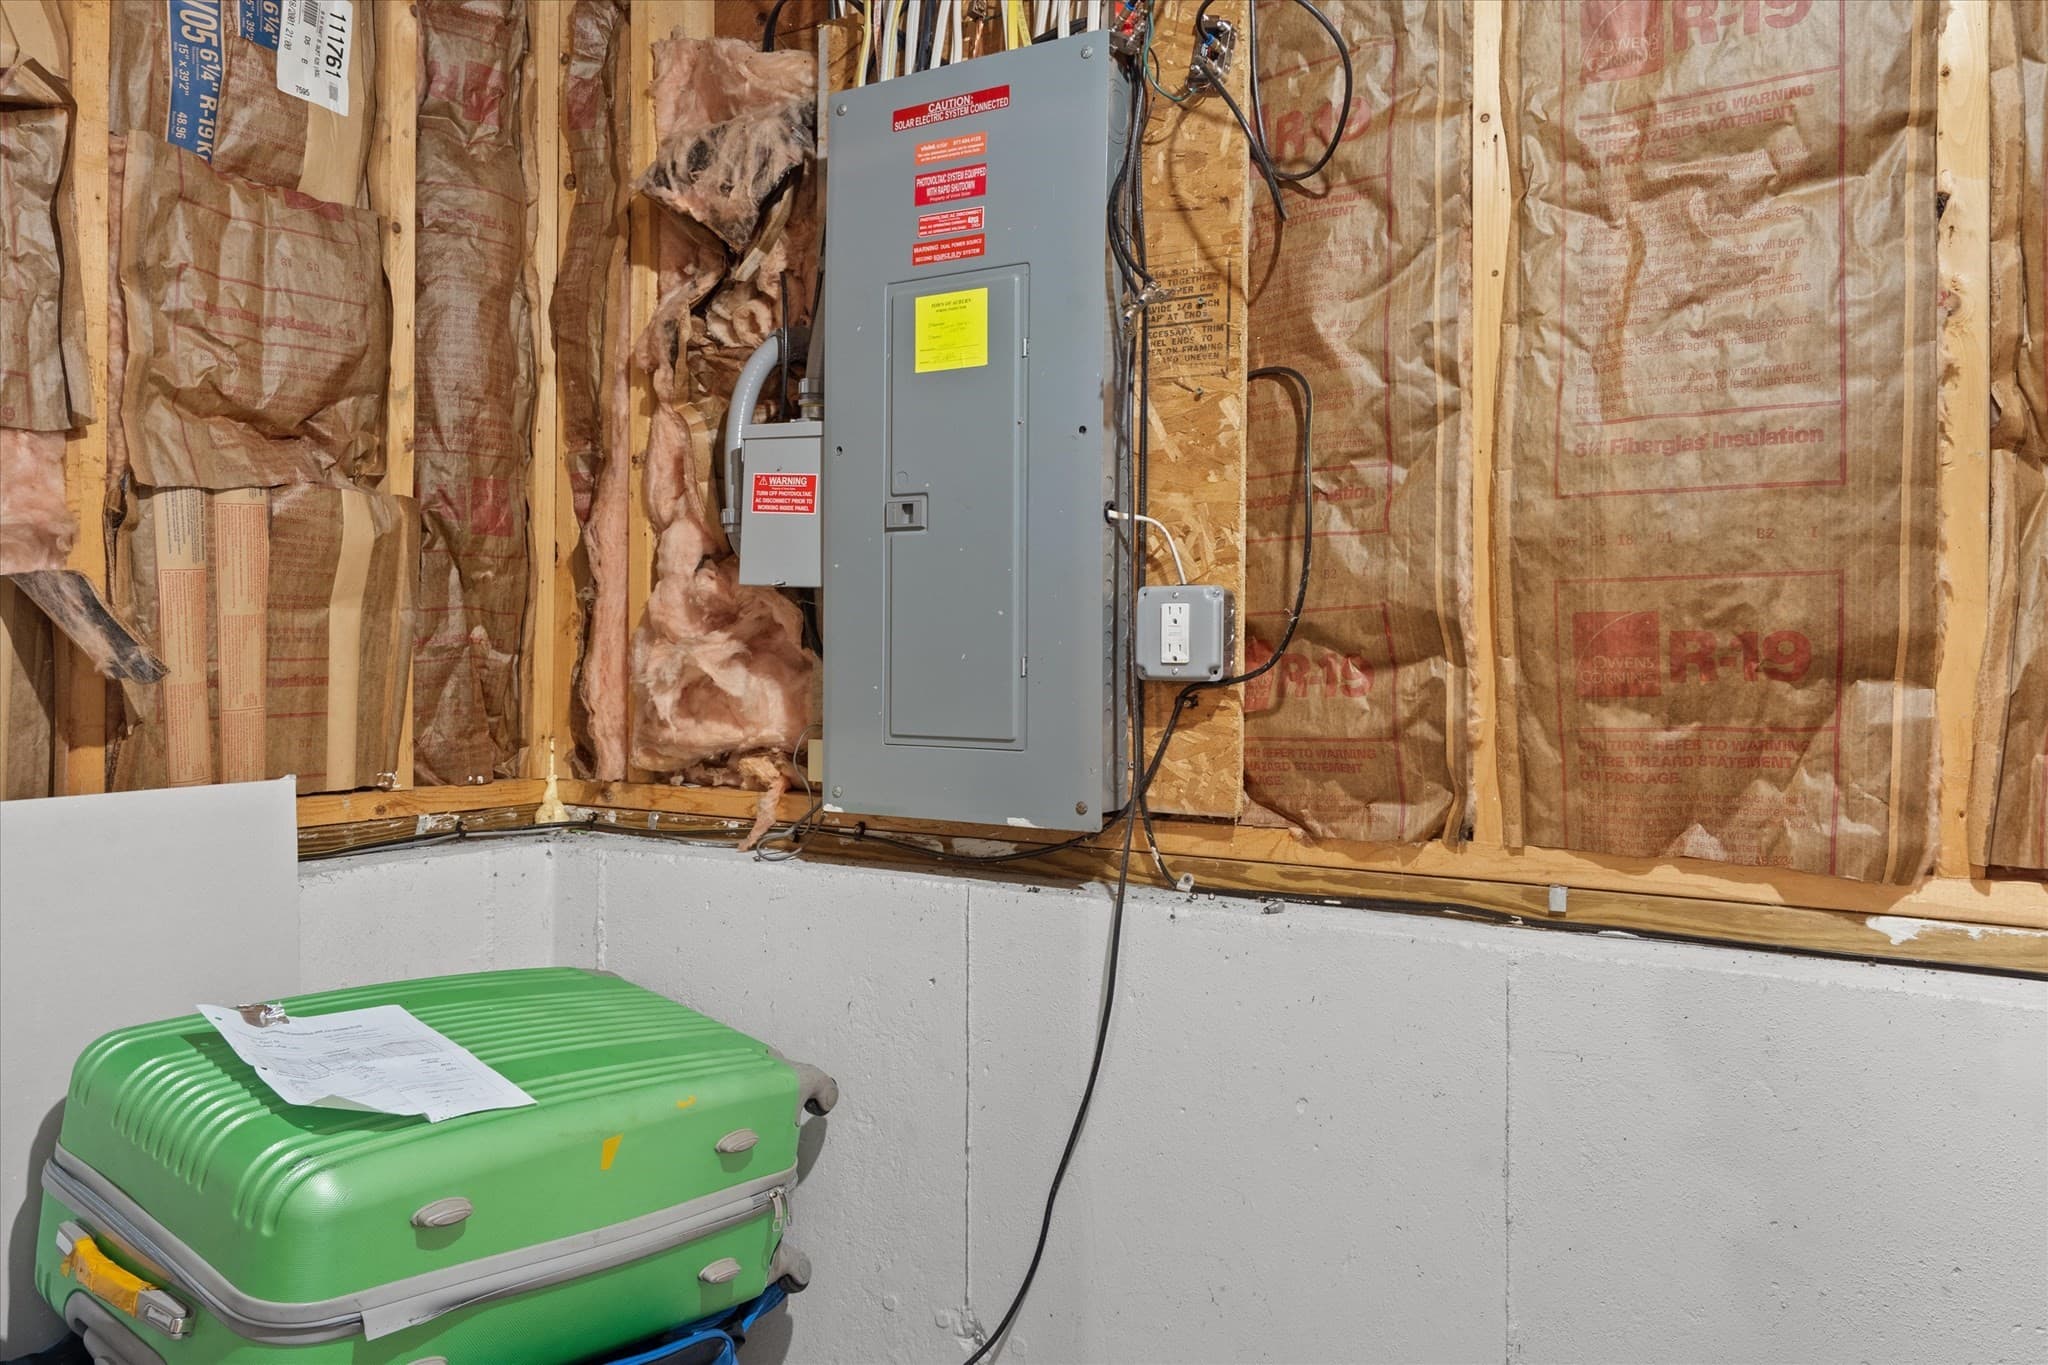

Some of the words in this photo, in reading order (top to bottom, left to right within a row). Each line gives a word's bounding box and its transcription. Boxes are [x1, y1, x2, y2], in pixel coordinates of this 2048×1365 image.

[1672, 0, 1814, 51] R-19
[324, 12, 347, 80] 111761
[928, 95, 974, 113] CAUTION:
[1654, 107, 1700, 124] REFER
[1708, 101, 1727, 114] TO
[1732, 84, 1816, 109] WARNING
[198, 95, 217, 140] R-19
[894, 119, 914, 131] SOLAR
[915, 111, 944, 126] ELECTRIC
[944, 106, 969, 120] SYSTEM
[970, 97, 1009, 114] CONNECTED
[176, 112, 188, 139] 48.96
[1595, 136, 1626, 152] FIRE
[1696, 104, 1797, 133] STATEMENT
[947, 170, 964, 182] SYSTEM
[964, 166, 987, 179] EQUIPPED
[926, 186, 938, 197] WITH
[937, 184, 951, 195] RAPID
[950, 180, 976, 192] SHUTDOWN
[1149, 305, 1172, 314] VIDE
[1151, 315, 1164, 323] AP
[1168, 313, 1178, 321] AT
[1202, 324, 1224, 332] TRIM
[1166, 346, 1178, 354] ON
[1182, 342, 1223, 353] FRAMING
[1172, 336, 1195, 346] ENDS
[1202, 334, 1213, 342] TO
[1713, 427, 1825, 449] Insulation
[769, 477, 807, 486] WARNING
[1756, 526, 1777, 540] B2
[1593, 656, 1656, 671] OWENS
[1669, 630, 1812, 683] R-19
[1277, 652, 1375, 699] R-19
[1578, 669, 1656, 685] CORNING
[1299, 748, 1313, 757] TO
[1315, 748, 1377, 760] WARNING
[1653, 739, 1701, 752] REFER
[1708, 739, 1728, 751] TO
[1732, 739, 1812, 753] WARNING
[1295, 762, 1363, 774] STATEMENT
[1594, 756, 1625, 768] FIRE
[1628, 756, 1694, 769] HAZARD
[1698, 756, 1795, 769] STATEMENT
[1579, 771, 1600, 783] ON
